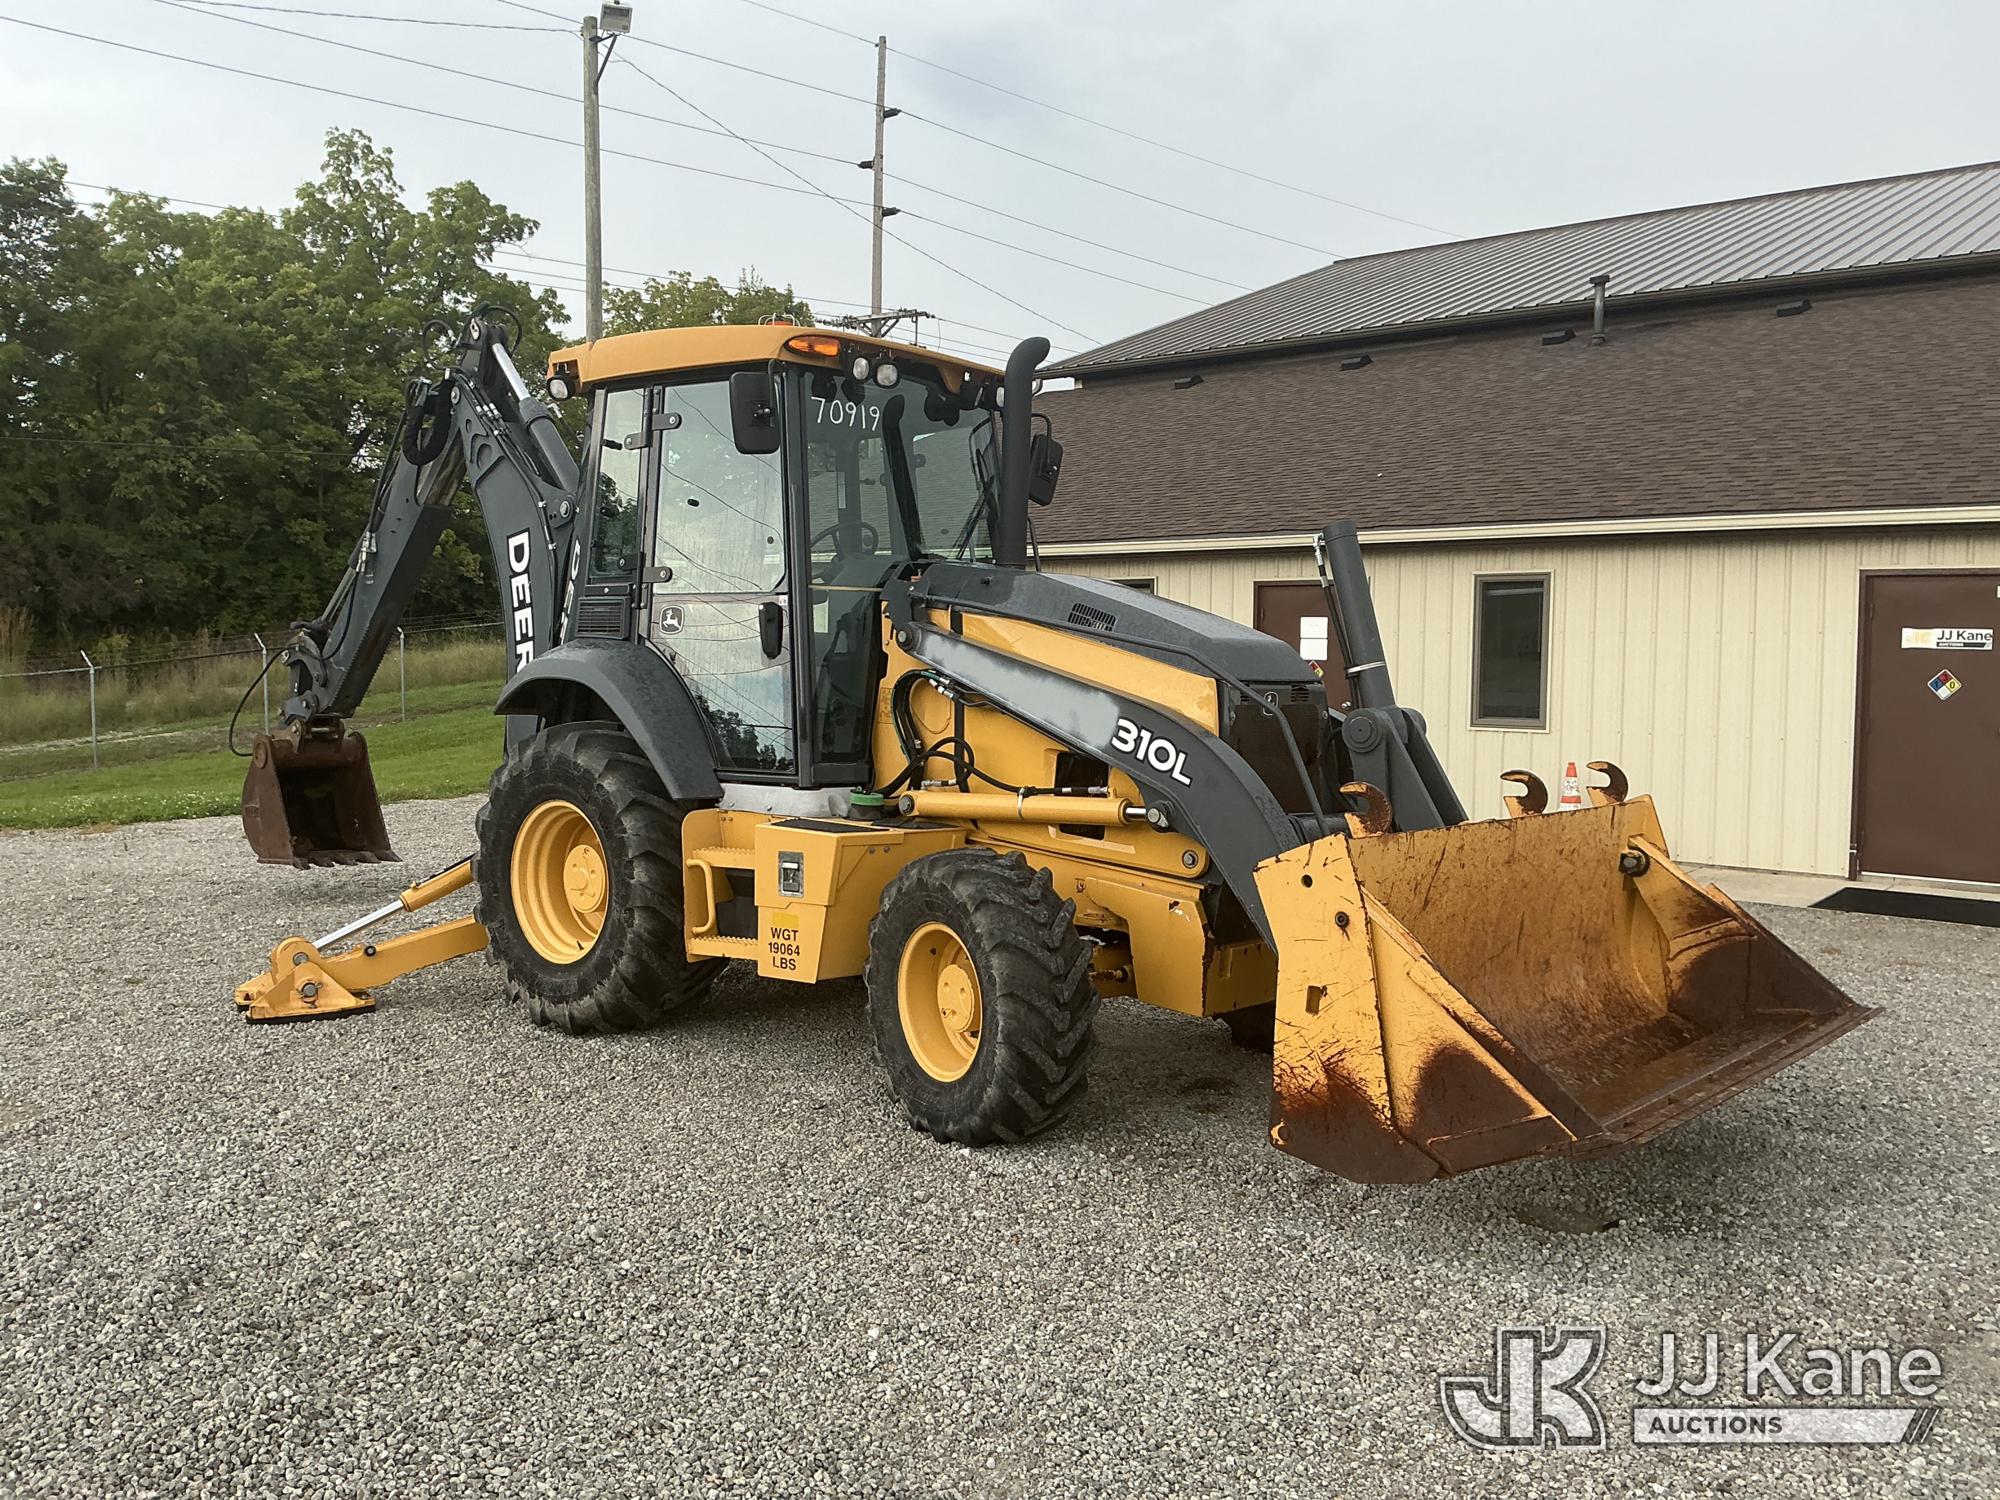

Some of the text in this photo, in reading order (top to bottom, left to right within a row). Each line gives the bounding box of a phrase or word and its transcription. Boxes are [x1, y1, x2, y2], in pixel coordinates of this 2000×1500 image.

[810, 396, 880, 431] 70919
[1937, 630, 1953, 641] JJ
[1956, 630, 1993, 641] Kane
[1110, 717, 1193, 787] 310L
[770, 926, 799, 942] WGT
[768, 941, 801, 957] 19064
[772, 956, 797, 971] LBS
